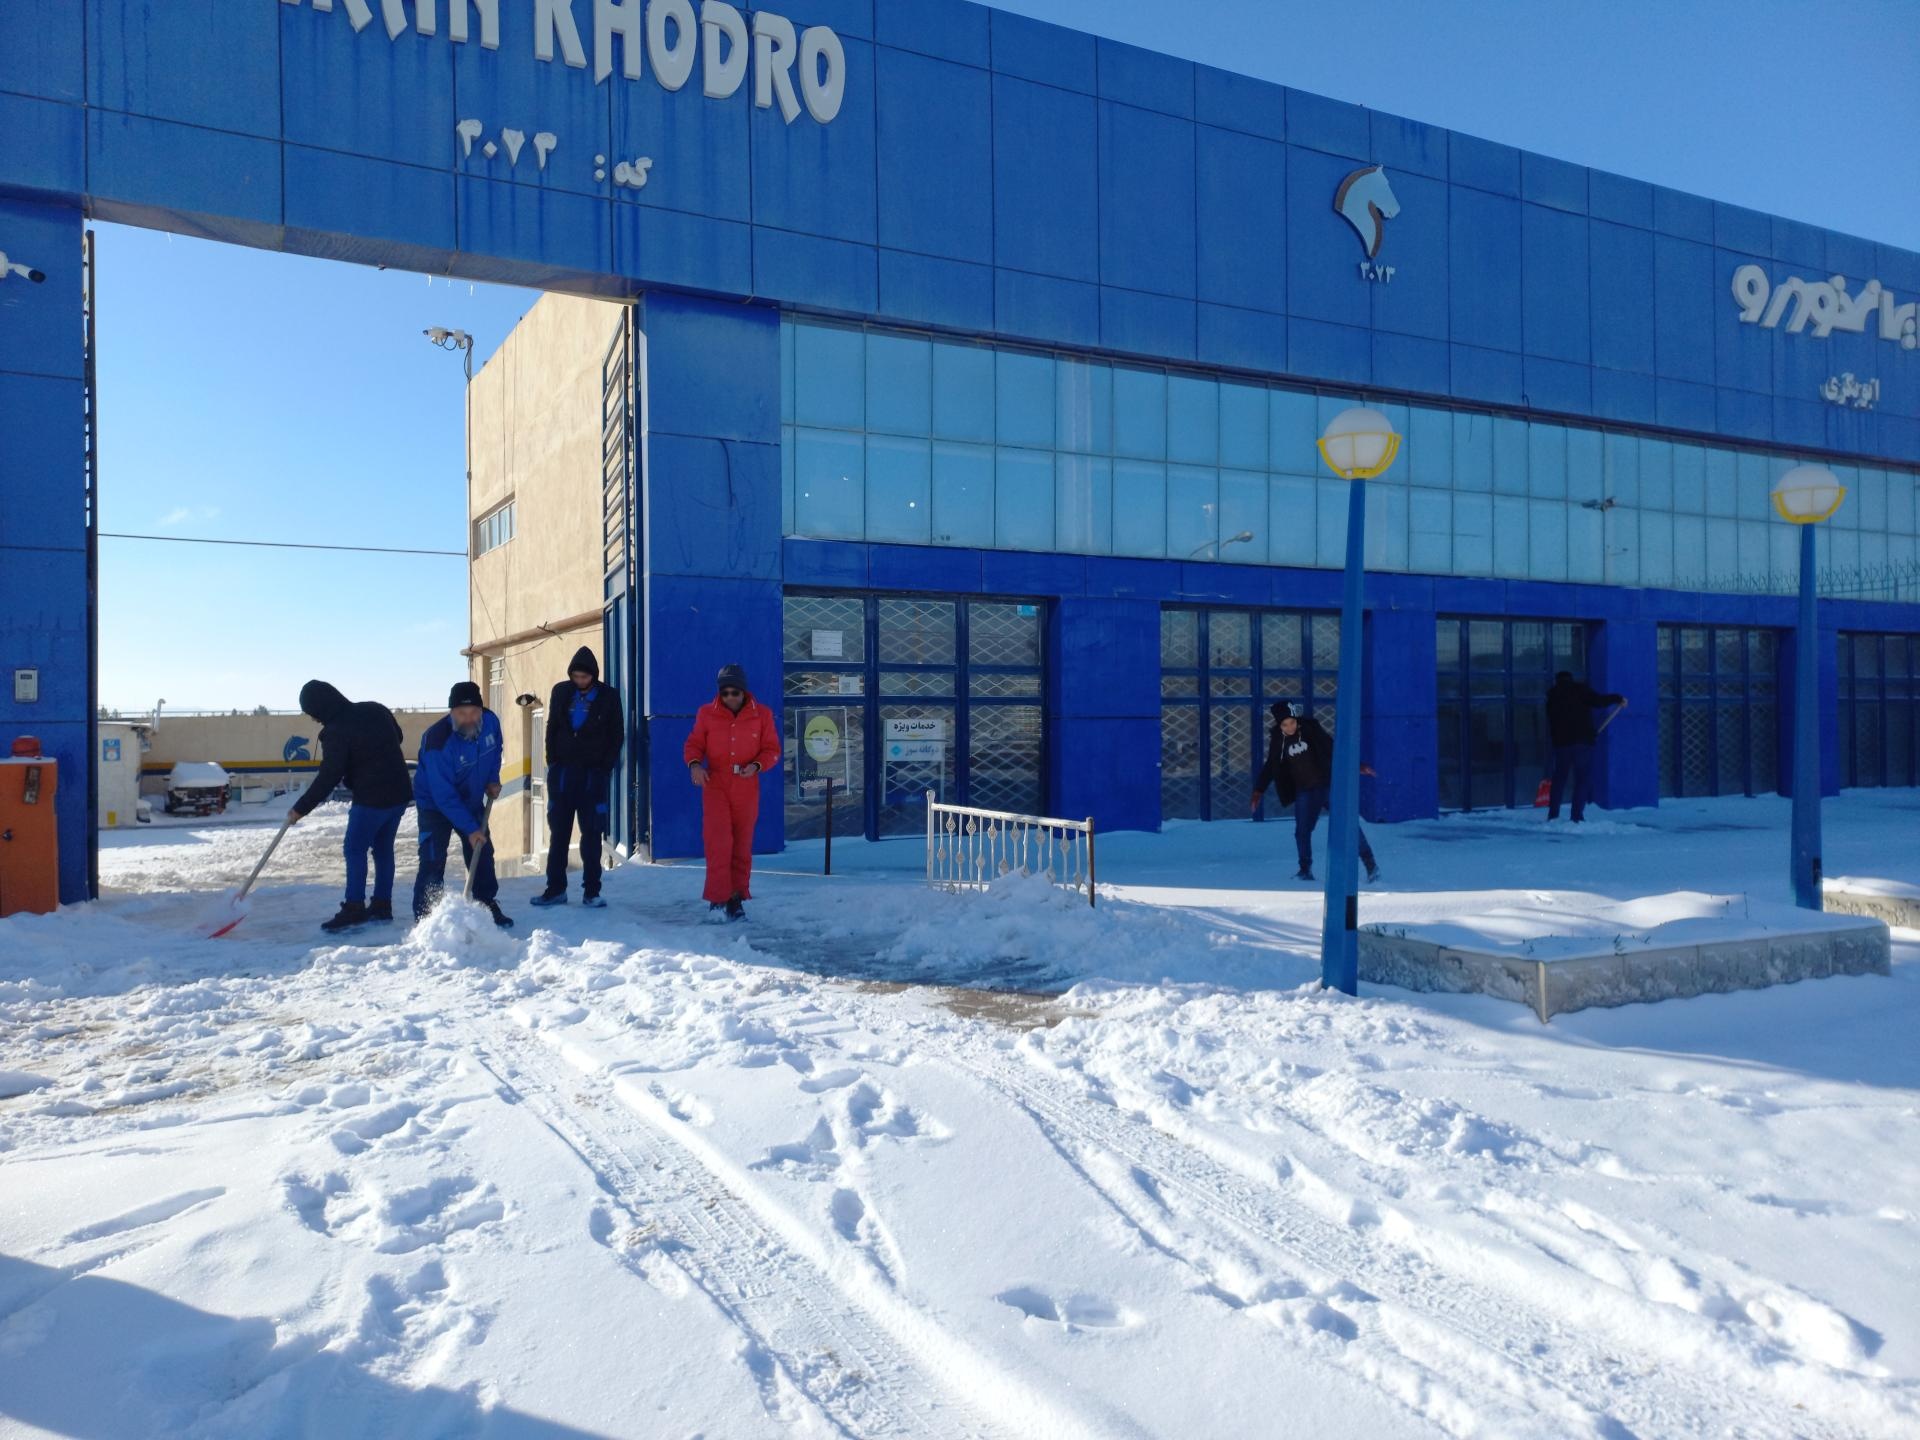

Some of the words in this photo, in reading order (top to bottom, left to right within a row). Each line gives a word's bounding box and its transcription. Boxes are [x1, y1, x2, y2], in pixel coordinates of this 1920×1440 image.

[534, 0, 846, 124] KHODRO
[893, 722, 910, 732] ویژه
[910, 721, 936, 730] خدمات
